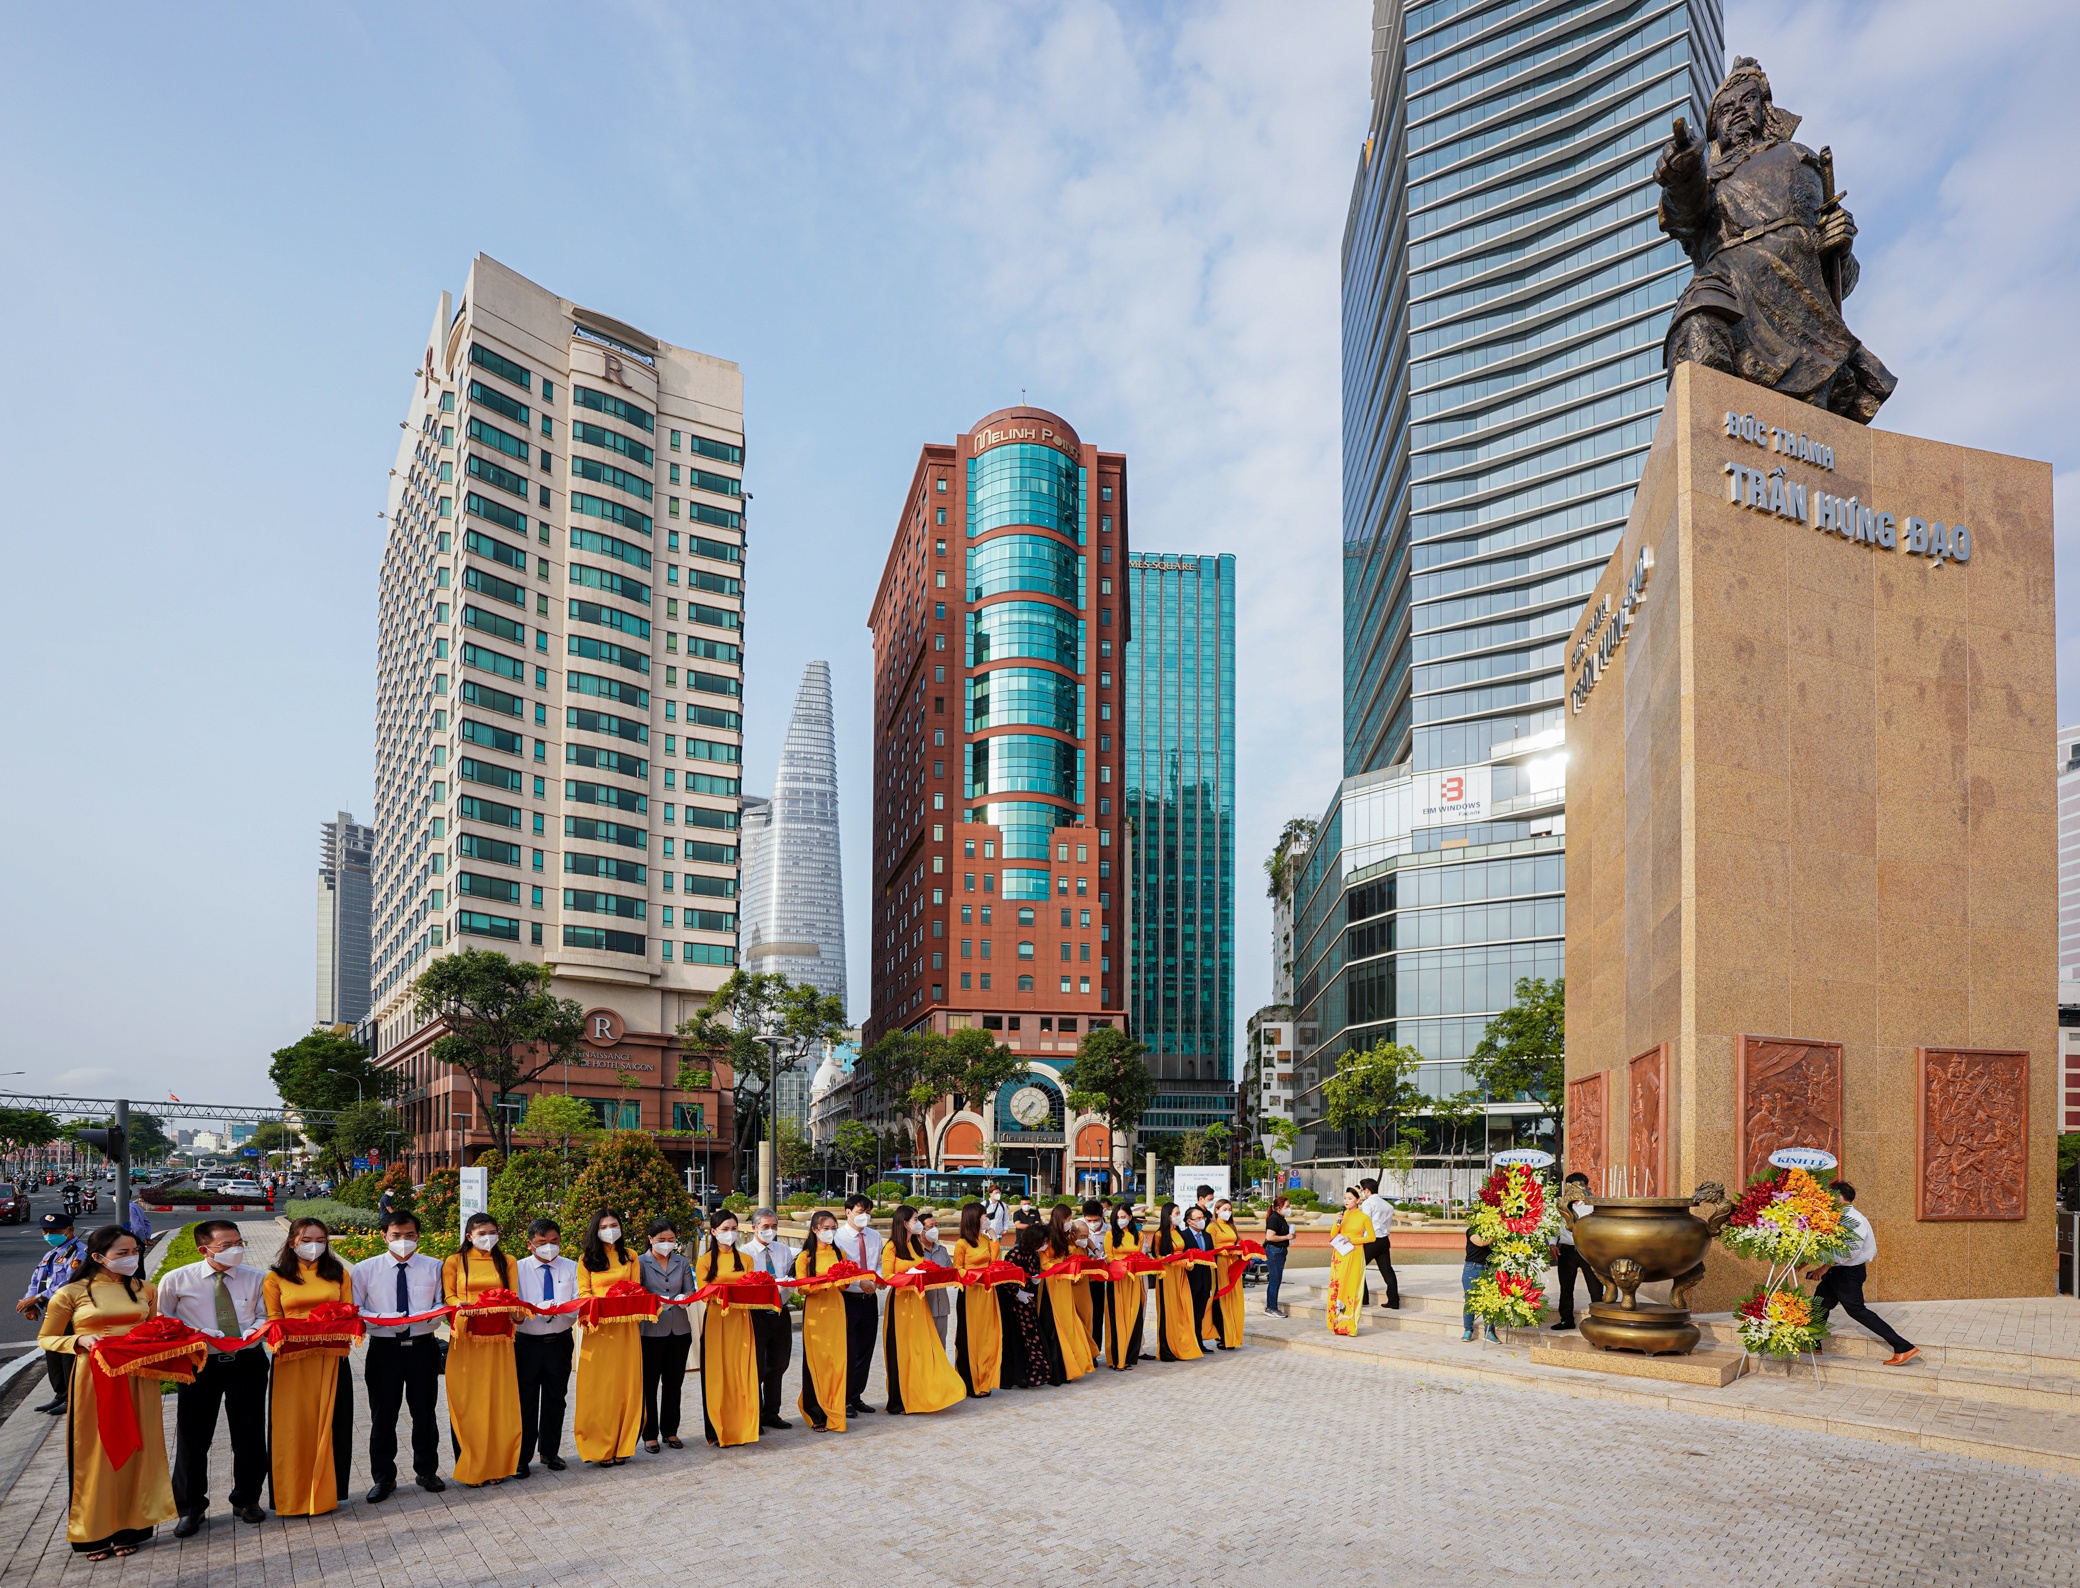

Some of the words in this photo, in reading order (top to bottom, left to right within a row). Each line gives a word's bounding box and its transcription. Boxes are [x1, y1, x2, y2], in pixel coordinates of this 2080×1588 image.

[602, 352, 633, 389] R
[974, 428, 1036, 454] MELINH
[1041, 427, 1080, 460] POINT
[1724, 411, 1768, 447] ĐỨC
[1771, 426, 1835, 472] THÁNH
[1725, 461, 1807, 525] TRẦN
[1814, 491, 1896, 551] HƯNG
[1902, 516, 1971, 569] ĐẠO
[1128, 560, 1149, 569] MES
[1152, 561, 1195, 572] SQUARE
[1439, 802, 1481, 812] WINDOWS
[593, 1017, 618, 1040] R
[592, 1060, 619, 1069] HOTEL
[621, 1062, 654, 1072] SAIGON
